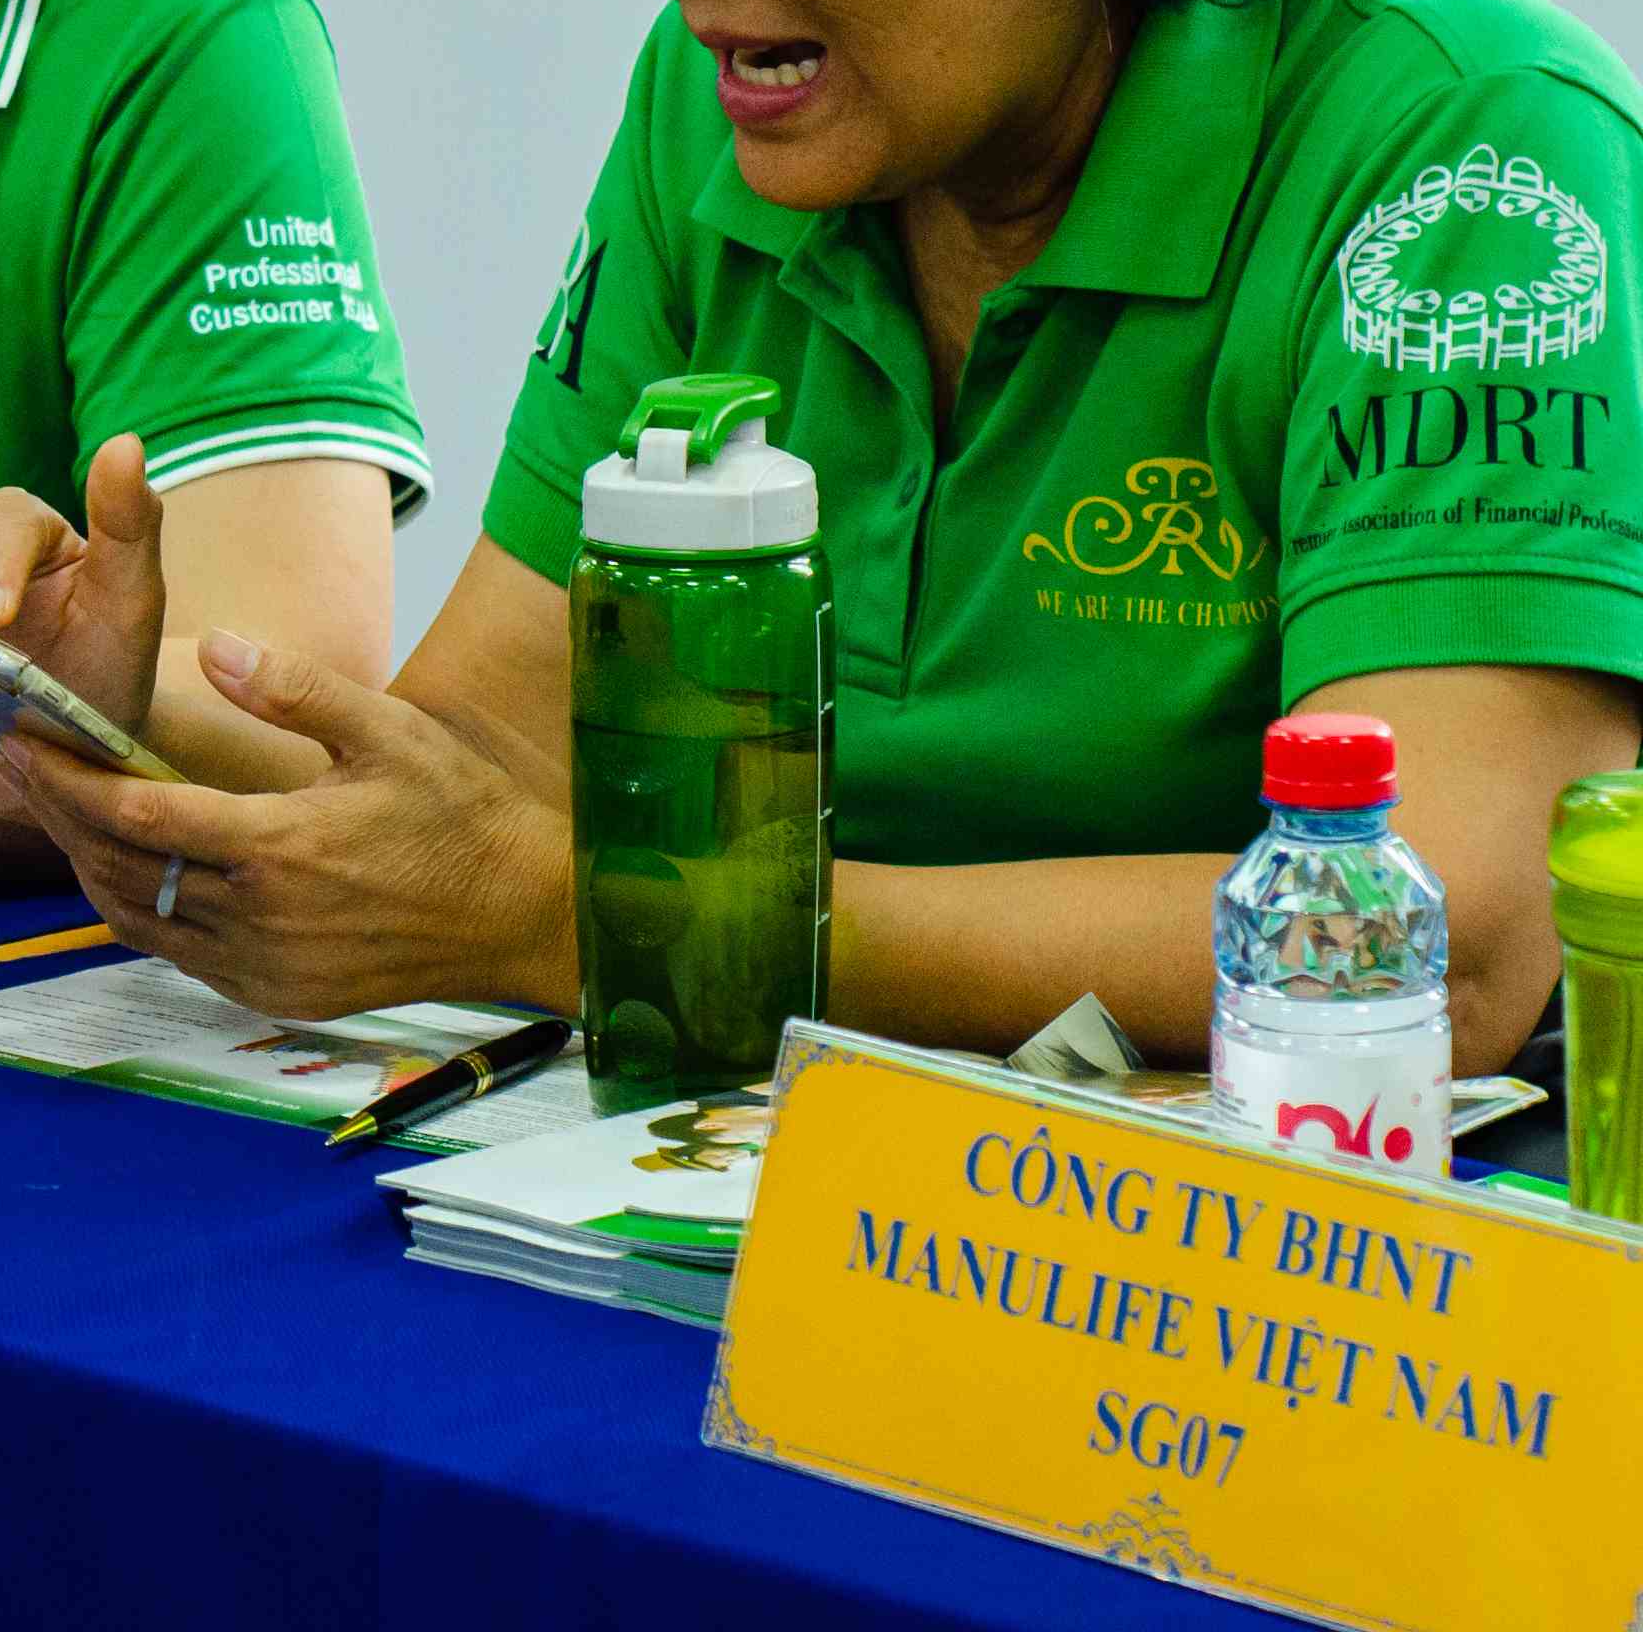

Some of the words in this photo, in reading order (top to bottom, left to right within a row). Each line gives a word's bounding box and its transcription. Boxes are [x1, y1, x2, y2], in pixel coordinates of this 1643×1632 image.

[244, 215, 336, 249] United
[189, 298, 334, 335] Customer
[1318, 383, 1611, 489] MDRT
[1443, 497, 1466, 525] of
[1473, 496, 1564, 529] Financial
[1036, 588, 1064, 617] WE
[1123, 596, 1171, 625] THE
[964, 1125, 1157, 1236] CÔNG
[1174, 1179, 1267, 1263] TY
[1278, 1208, 1474, 1316] BHNT
[846, 1209, 1194, 1361] MANULIFE
[1214, 1304, 1375, 1412] VIỆT
[1386, 1354, 1558, 1460] NAM
[1089, 1389, 1247, 1489] SG07
